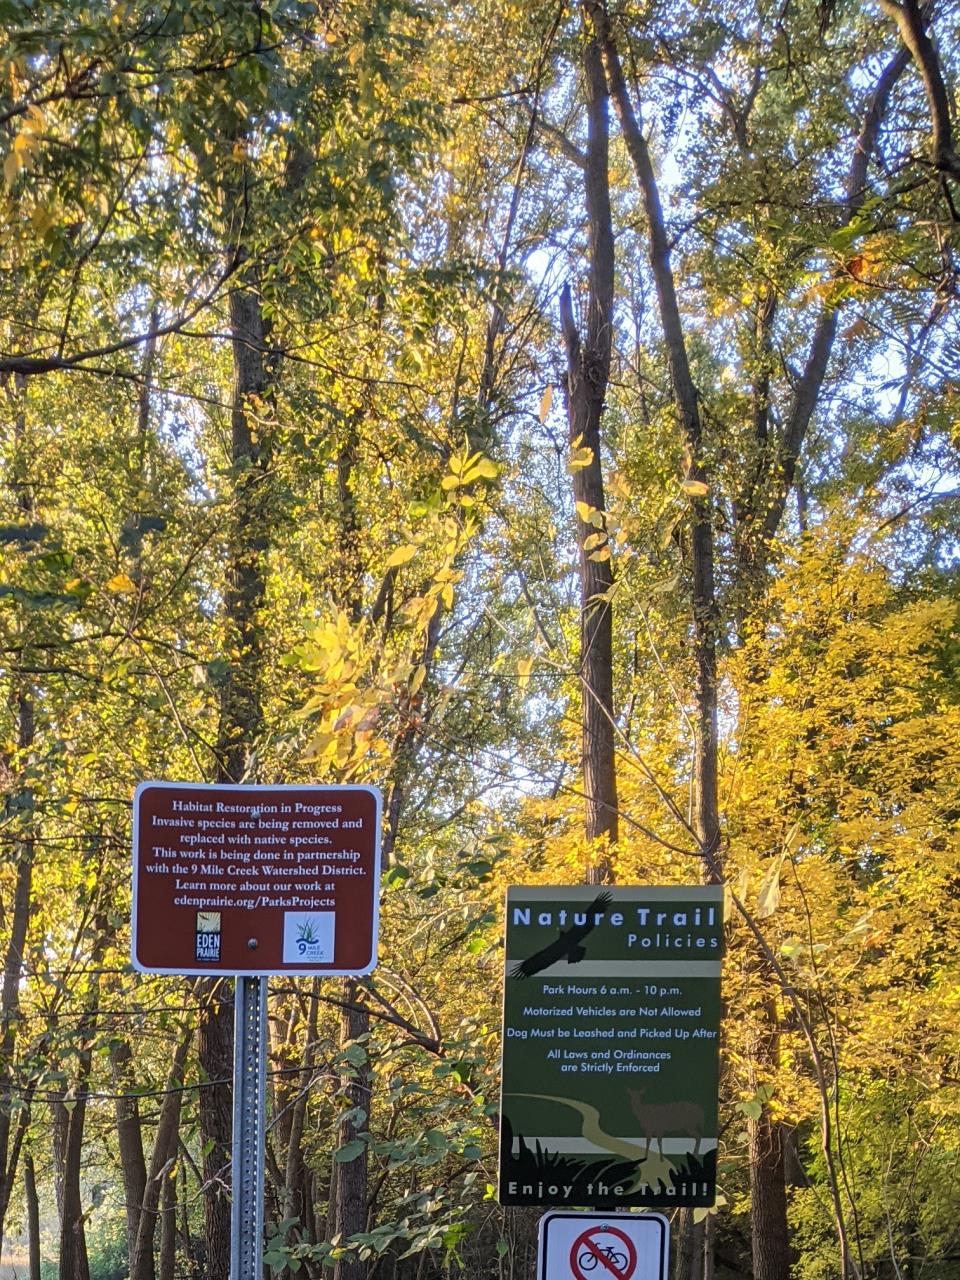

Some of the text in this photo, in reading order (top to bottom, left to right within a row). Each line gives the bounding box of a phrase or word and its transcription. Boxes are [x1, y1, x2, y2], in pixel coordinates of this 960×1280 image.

[173, 801, 342, 816] Habitat Restoration in Progress
[152, 816, 362, 830] Invasive species are being removed and
[180, 833, 332, 847] replaced with native species.
[152, 848, 360, 862] This work is being done in partnership
[146, 864, 366, 875] with the 9 Mile Creek Watershed District.
[176, 880, 335, 891] Learn more about our work at
[174, 895, 336, 909] edenprairie.org/ParksProjects
[513, 908, 714, 926] Nature Trail
[197, 935, 220, 948] EDEN
[628, 934, 718, 948] Policies
[197, 947, 220, 958] PRAIRIE
[299, 943, 306, 955] 9
[543, 985, 565, 994] Park
[567, 986, 597, 995] Hours
[600, 985, 607, 995] 6
[610, 987, 632, 995] a.m.
[644, 986, 657, 995] 10
[660, 987, 682, 998] p.m.
[523, 1007, 573, 1016] Motorized
[576, 1007, 616, 1017] Vehicles
[639, 1008, 658, 1017] Not
[661, 1007, 701, 1017] Allowed
[507, 1028, 717, 1041] Dog Must be Leashed and Picked Up After
[547, 1050, 671, 1059] All Laws and Ordinances
[561, 1063, 660, 1074] are Strictly Enforced
[508, 1182, 572, 1198] Enjoy
[587, 1183, 624, 1196] the
